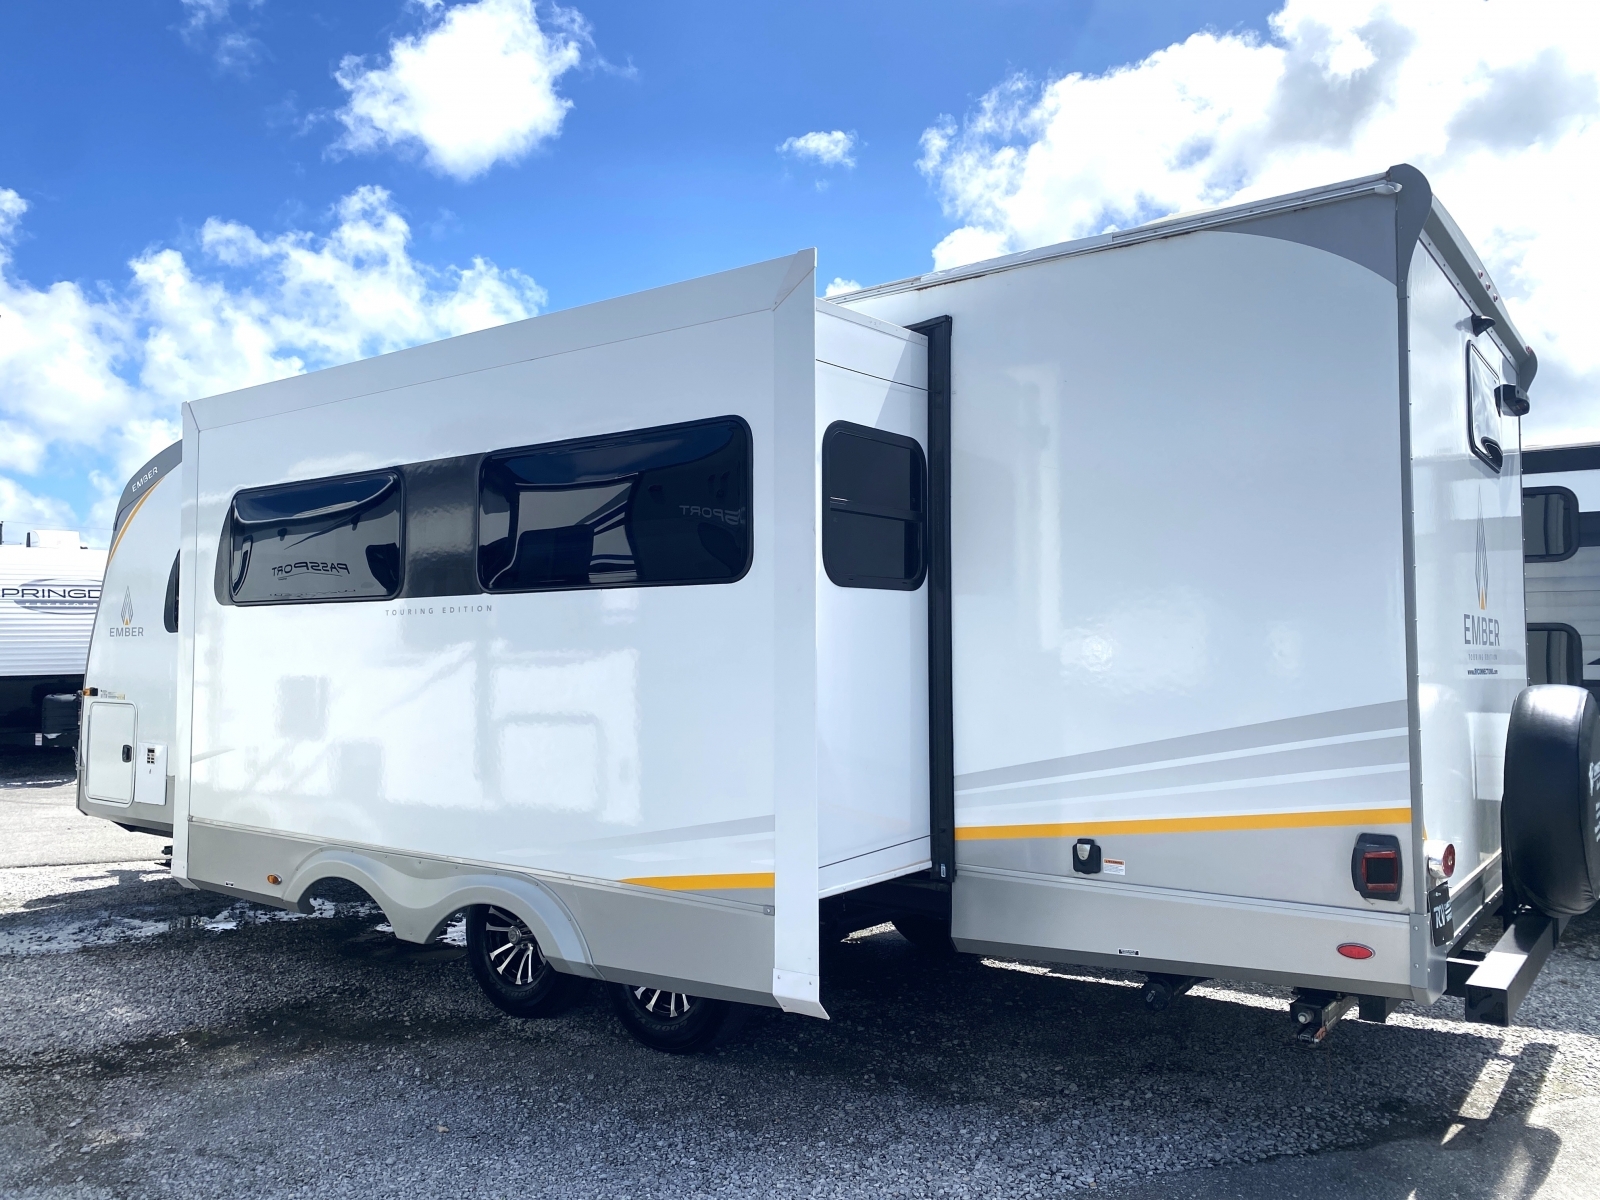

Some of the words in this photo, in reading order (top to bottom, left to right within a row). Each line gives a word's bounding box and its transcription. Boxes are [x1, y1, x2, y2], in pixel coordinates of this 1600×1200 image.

[131, 466, 158, 492] EMBER
[385, 607, 434, 616] TOURING
[442, 605, 492, 614] EDITION
[109, 626, 144, 637] EMBER
[1463, 613, 1500, 647] EMBER
